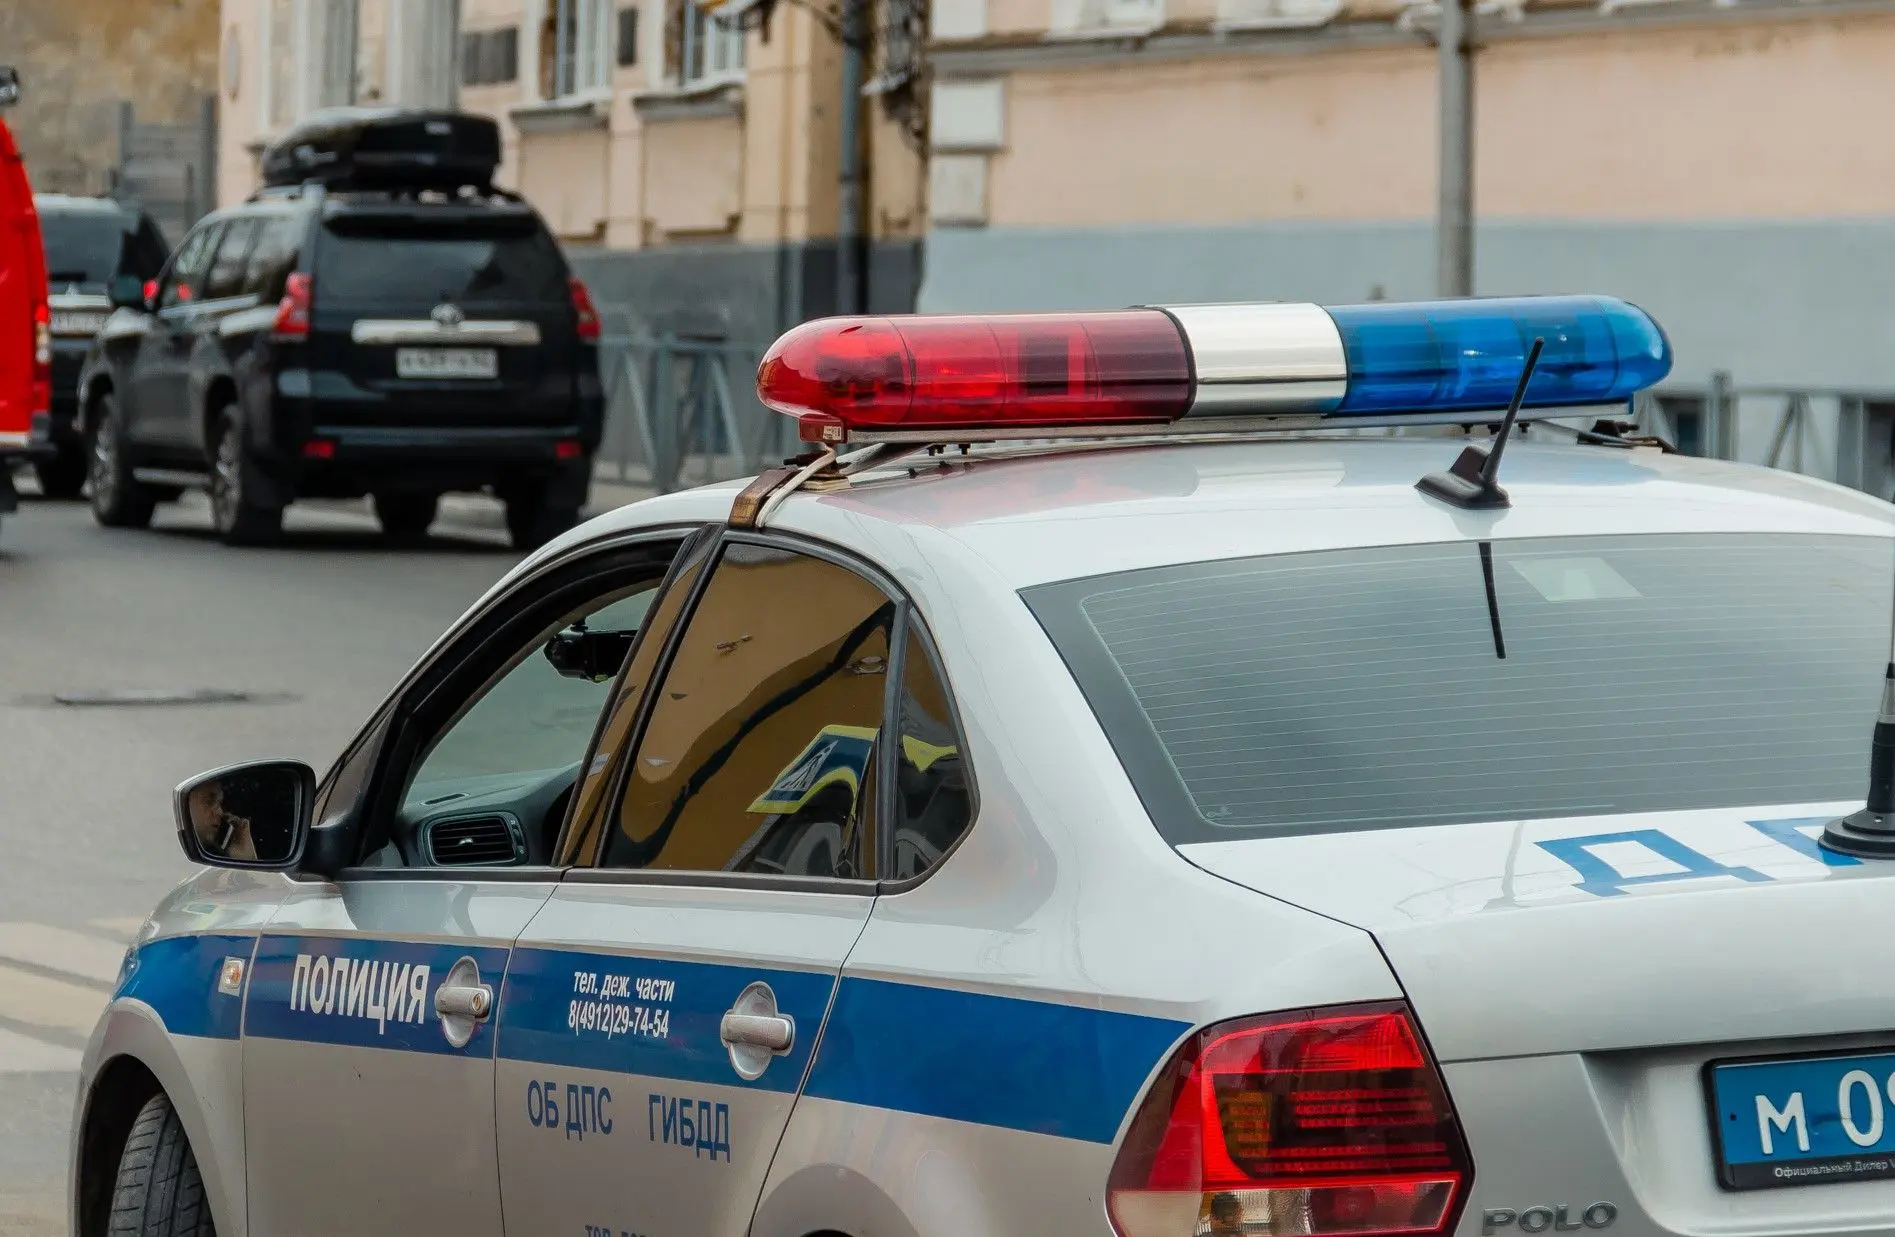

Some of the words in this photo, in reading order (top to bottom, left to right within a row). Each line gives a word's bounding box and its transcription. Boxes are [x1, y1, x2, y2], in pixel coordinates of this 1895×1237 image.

[290, 953, 431, 1035] ПОЛИЦИЯ
[573, 971, 598, 995] тел.
[600, 974, 630, 1001] деж.
[636, 977, 675, 1003] части
[568, 999, 670, 1040] 8(4912)29-74-54
[527, 1079, 560, 1129] ОБ
[565, 1083, 613, 1142] ДПС
[648, 1093, 731, 1163] ГИБДД
[1755, 1091, 1811, 1155] М
[1838, 1069, 1895, 1147] 0
[1774, 1162, 1853, 1178] Официальный
[1854, 1161, 1888, 1173] Дилер
[1481, 1200, 1618, 1236] POLO
